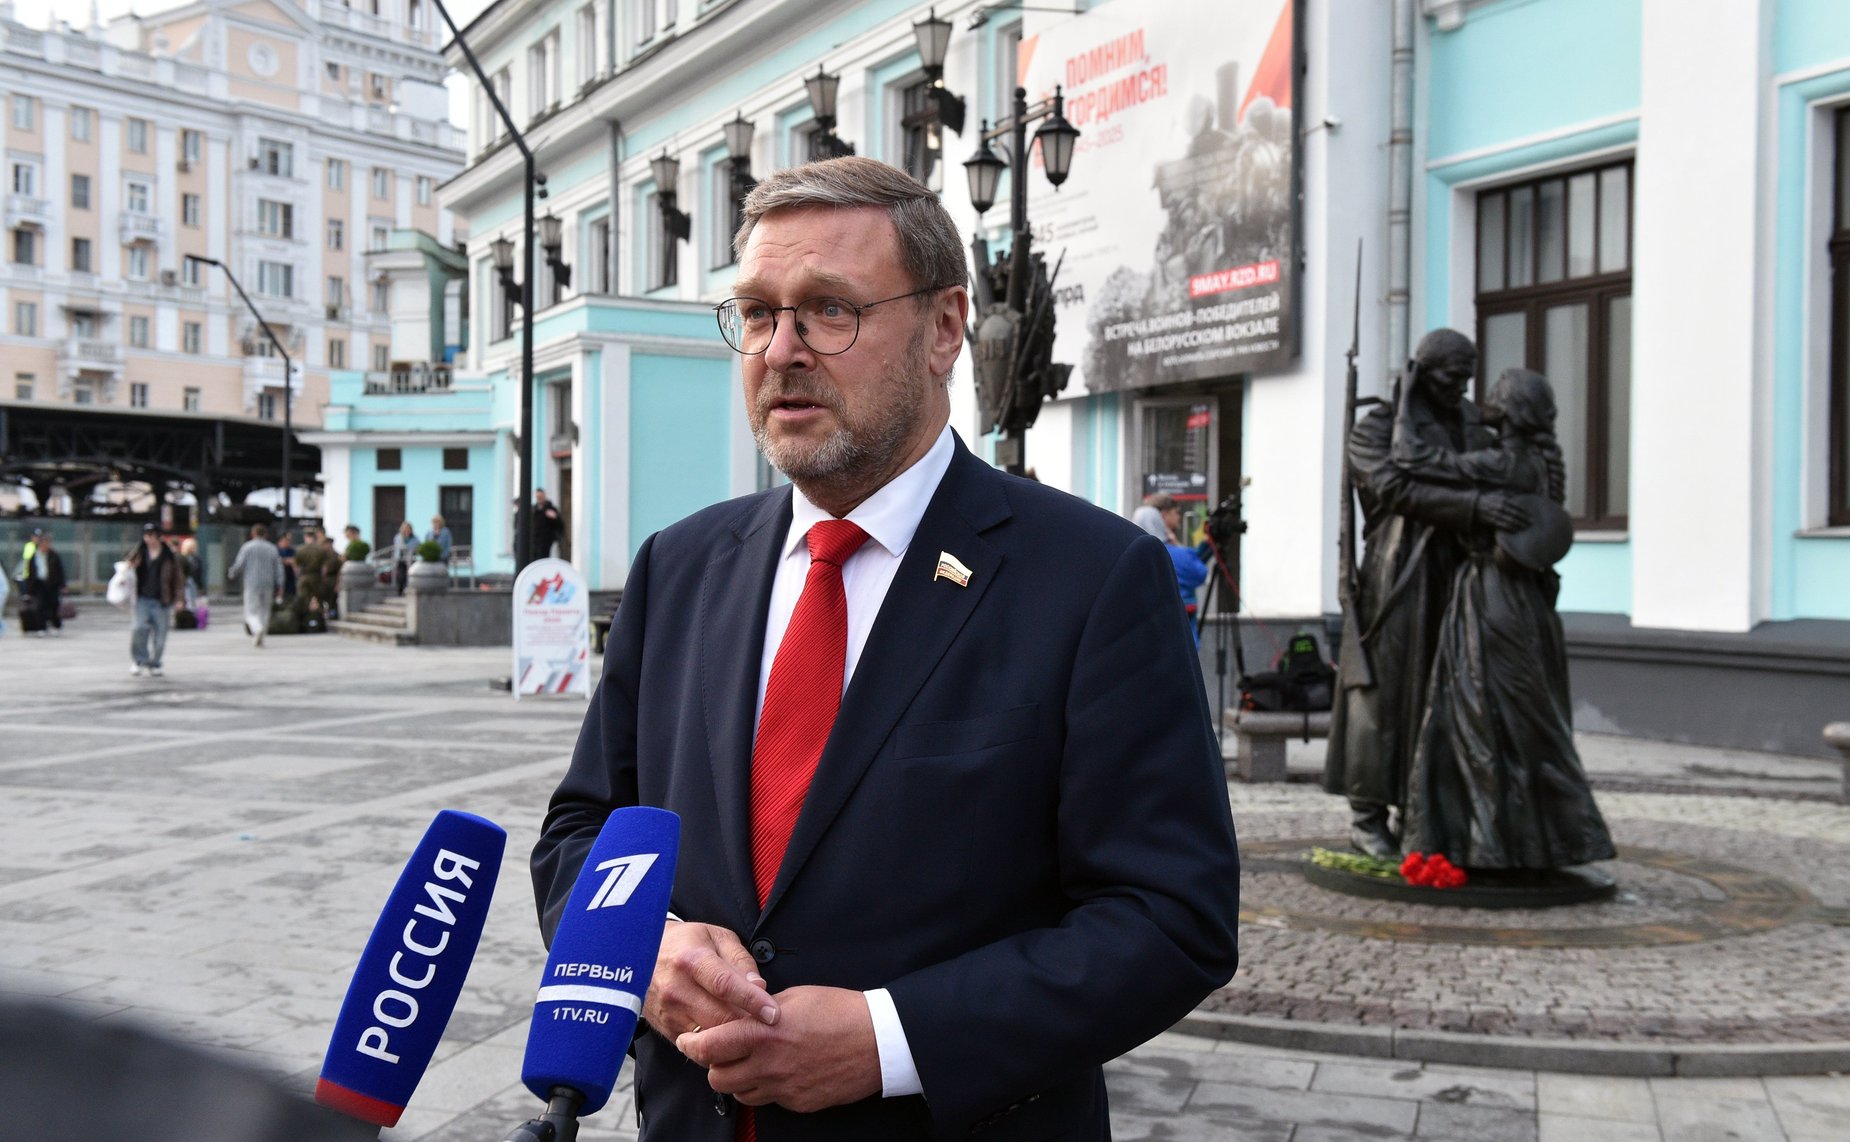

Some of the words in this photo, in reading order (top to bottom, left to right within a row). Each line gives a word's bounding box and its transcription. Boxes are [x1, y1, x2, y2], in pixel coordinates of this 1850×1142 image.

[1066, 28, 1150, 90] ПОМНИМ,
[1067, 64, 1168, 127] ГОРДИМСЯ!
[1191, 262, 1278, 295] 9MAY.RZD.RU
[1104, 319, 1148, 340] ВСТРЕЧА
[1148, 291, 1280, 332] ВОИНОВ-ПОБЕДИТЕЛЕЙ
[1127, 339, 1145, 356] НА
[1146, 326, 1224, 355] БЕЛОРУССКОМ
[1225, 317, 1280, 337] ВОКЗАЛЕ
[356, 848, 481, 1065] РОССИЯ
[554, 962, 634, 984] ПЕРВЫЙ
[552, 1007, 610, 1025] 1TV.RU
